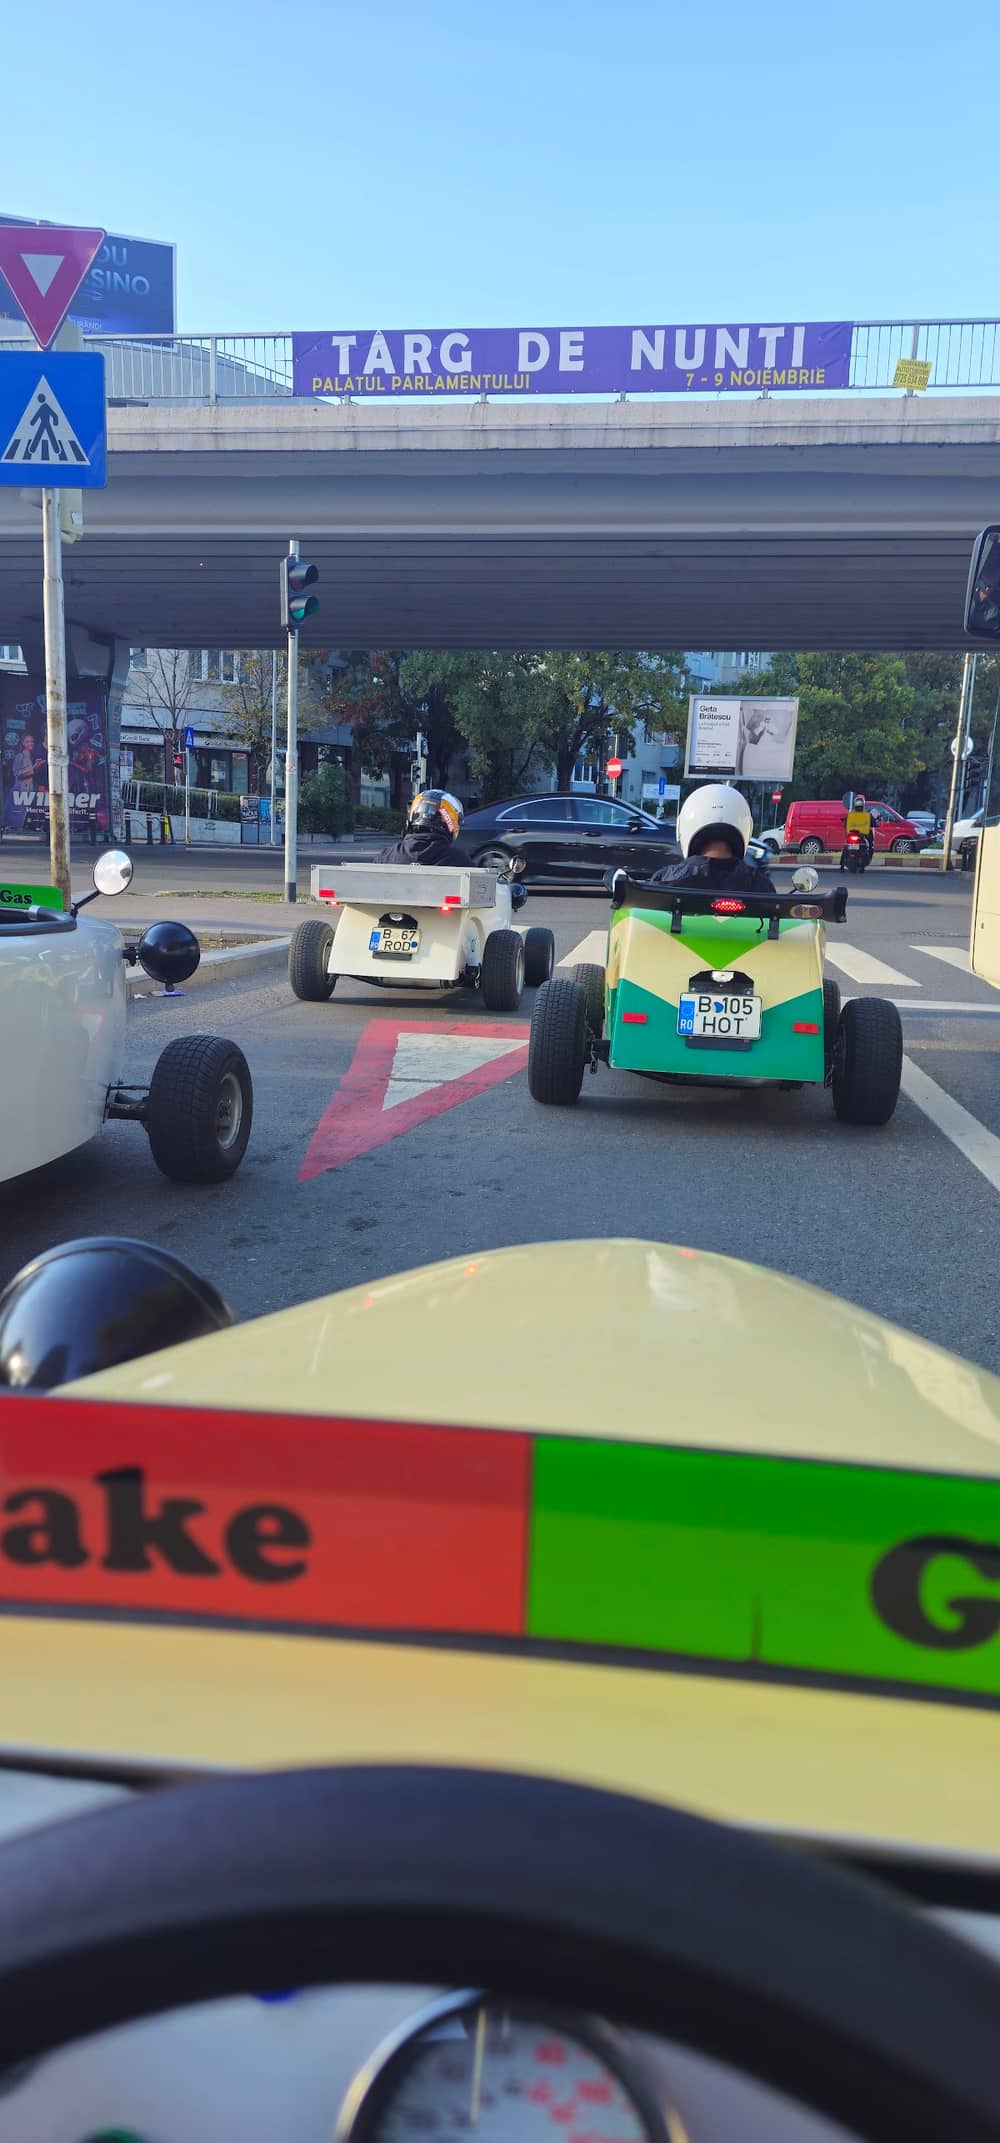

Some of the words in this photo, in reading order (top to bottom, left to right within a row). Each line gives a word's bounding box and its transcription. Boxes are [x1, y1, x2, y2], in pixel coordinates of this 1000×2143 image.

[517, 331, 585, 373] DE
[312, 376, 385, 392] PALATUL
[391, 373, 531, 391] PARLAMENTULUI
[685, 373, 695, 387] 7
[714, 372, 724, 386] 9
[729, 368, 826, 386] NOIEMBRIE
[0, 890, 33, 905] Gas
[383, 928, 392, 939] B
[401, 930, 417, 941] 67
[383, 940, 411, 951] ROD
[698, 996, 712, 1013] B
[722, 997, 754, 1015] 105
[680, 1019, 693, 1031] RO
[702, 1016, 744, 1035] HOT
